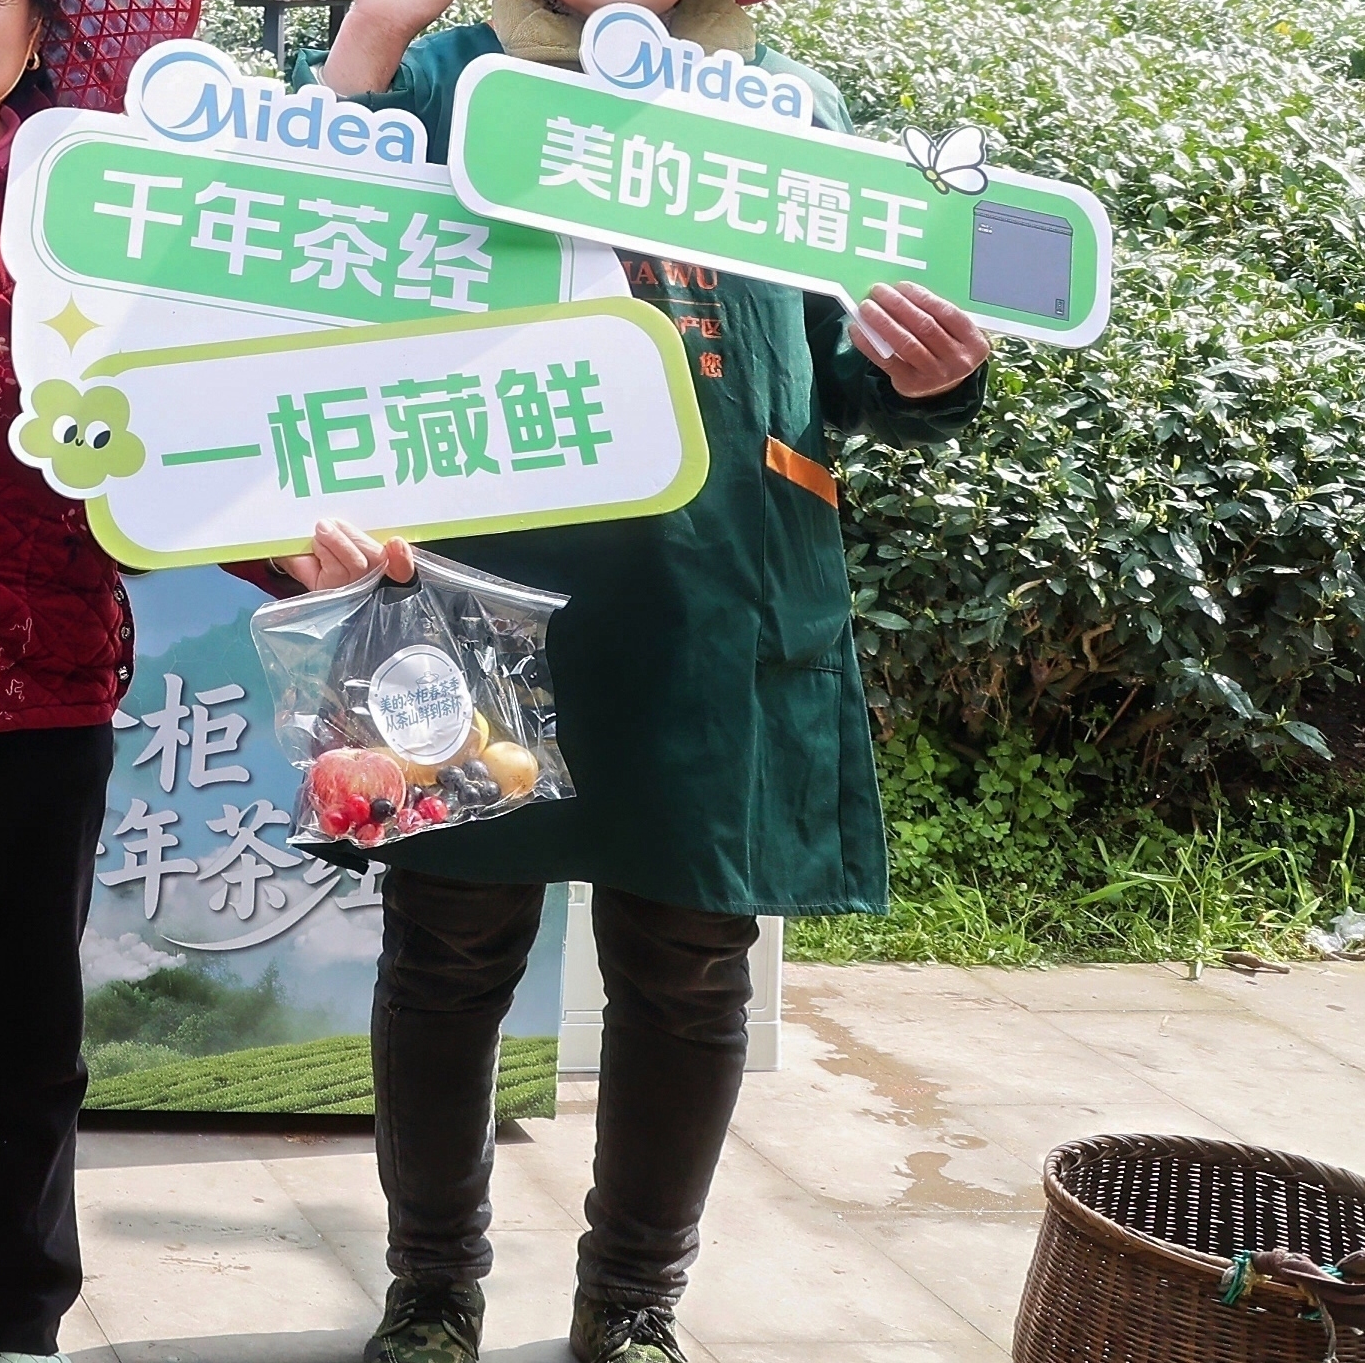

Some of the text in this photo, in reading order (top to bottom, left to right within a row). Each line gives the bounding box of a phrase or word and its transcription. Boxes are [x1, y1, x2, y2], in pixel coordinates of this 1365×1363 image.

[141, 51, 416, 164] Midea
[591, 11, 802, 119] Midea
[92, 169, 494, 314] 千年茶经
[537, 114, 930, 273] 美的无霜王
[674, 315, 723, 339] 产区
[160, 360, 614, 498] 一柜藏鲜
[113, 673, 251, 794] 柜
[379, 676, 460, 715] 美的冷柜春茶季
[385, 695, 463, 733] 从茶山鲜到茶杯
[95, 798, 384, 950] 年茶
